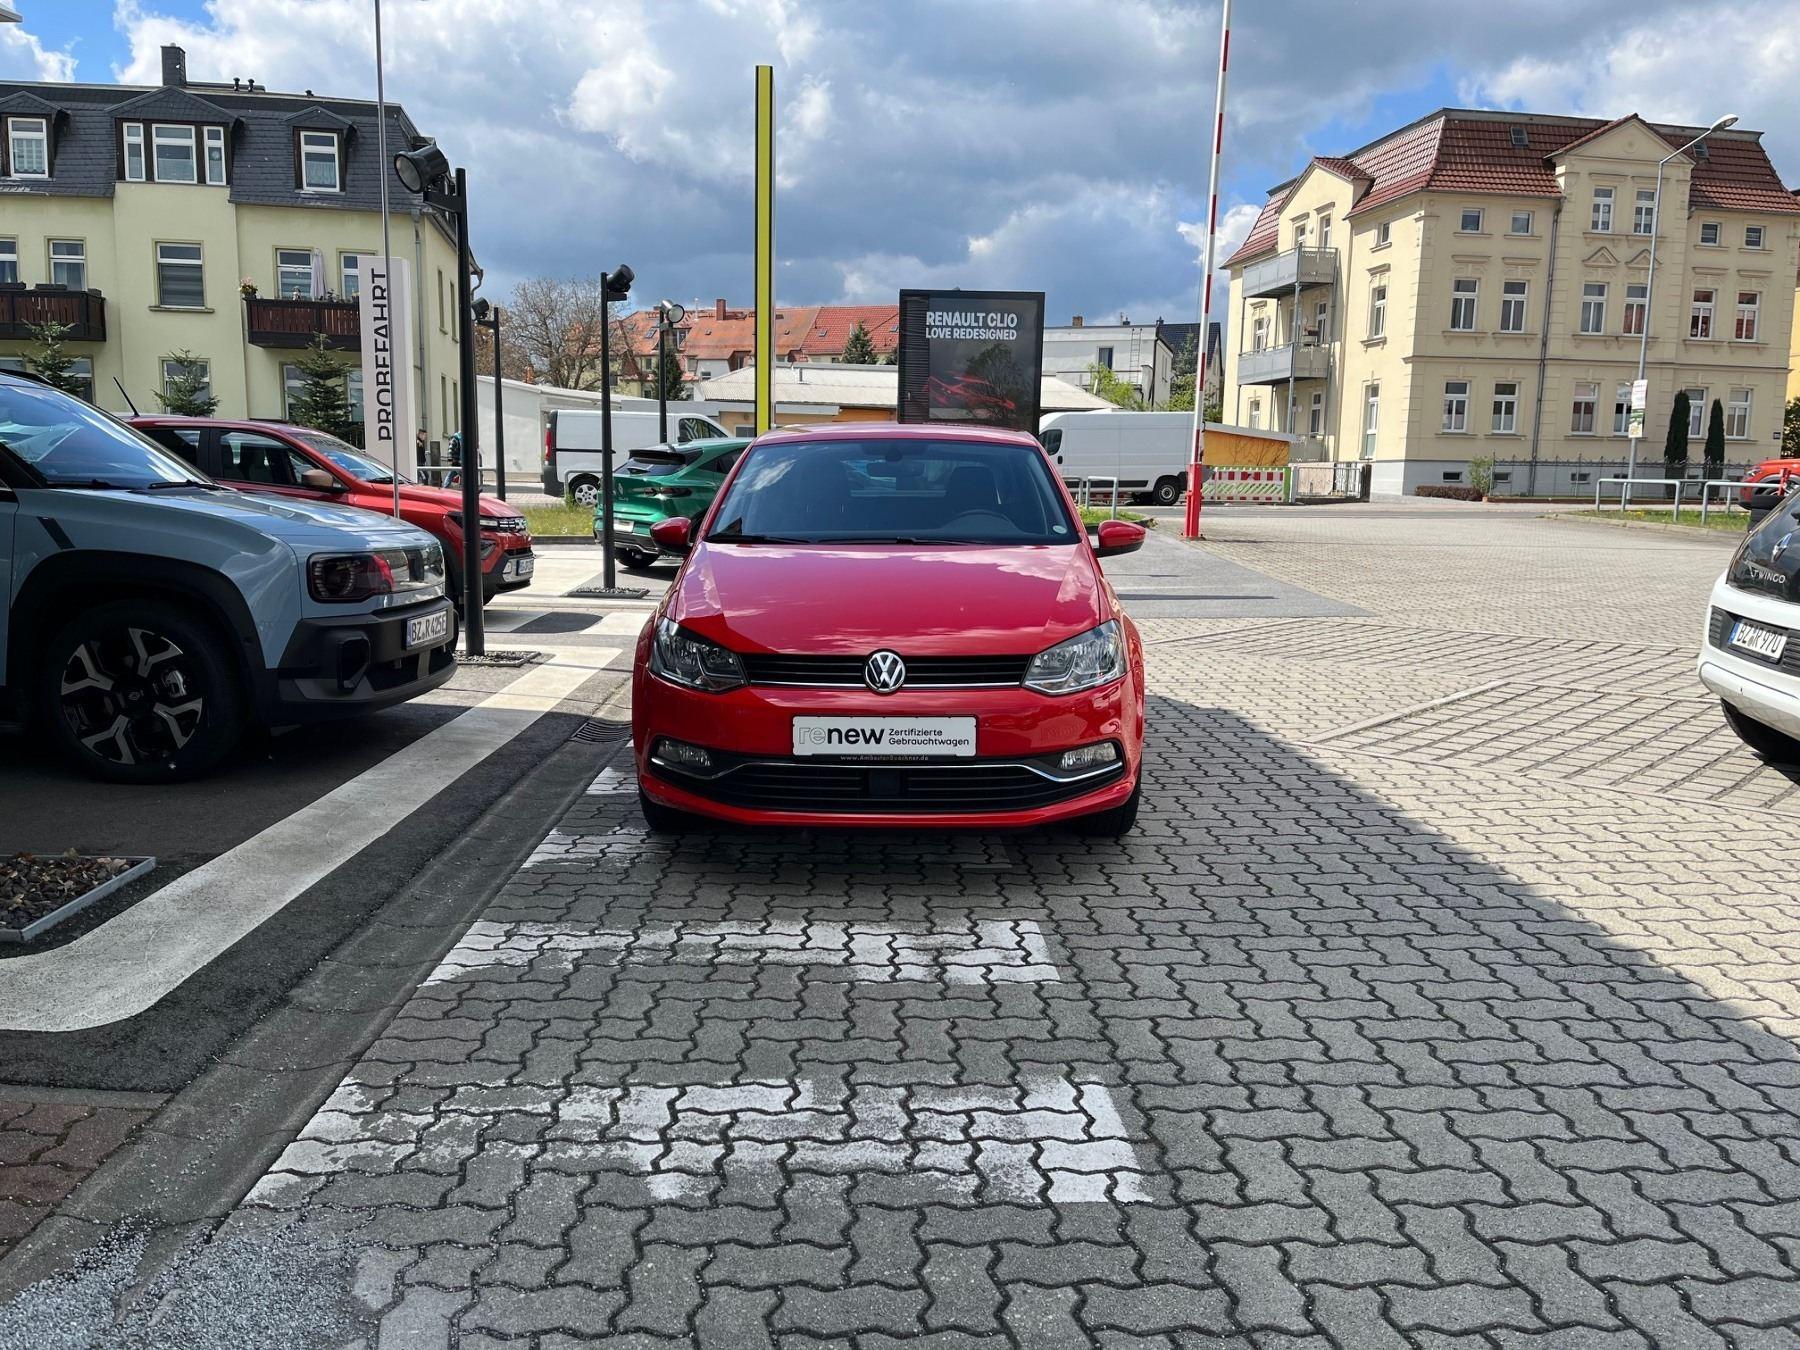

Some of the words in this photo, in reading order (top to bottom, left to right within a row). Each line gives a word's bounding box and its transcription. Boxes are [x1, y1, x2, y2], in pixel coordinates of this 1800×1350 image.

[926, 312, 986, 327] RENAULT
[987, 313, 1018, 327] CLIO
[925, 328, 952, 339] LOVE
[953, 328, 1017, 340] REDESIGNED
[1753, 569, 1786, 584] TWINGO
[411, 620, 422, 643] BZ
[1736, 622, 1754, 643] BZ
[798, 727, 885, 746] renew
[888, 728, 943, 737] Zertifizierte
[888, 737, 970, 747] Gebrauchtwagen
